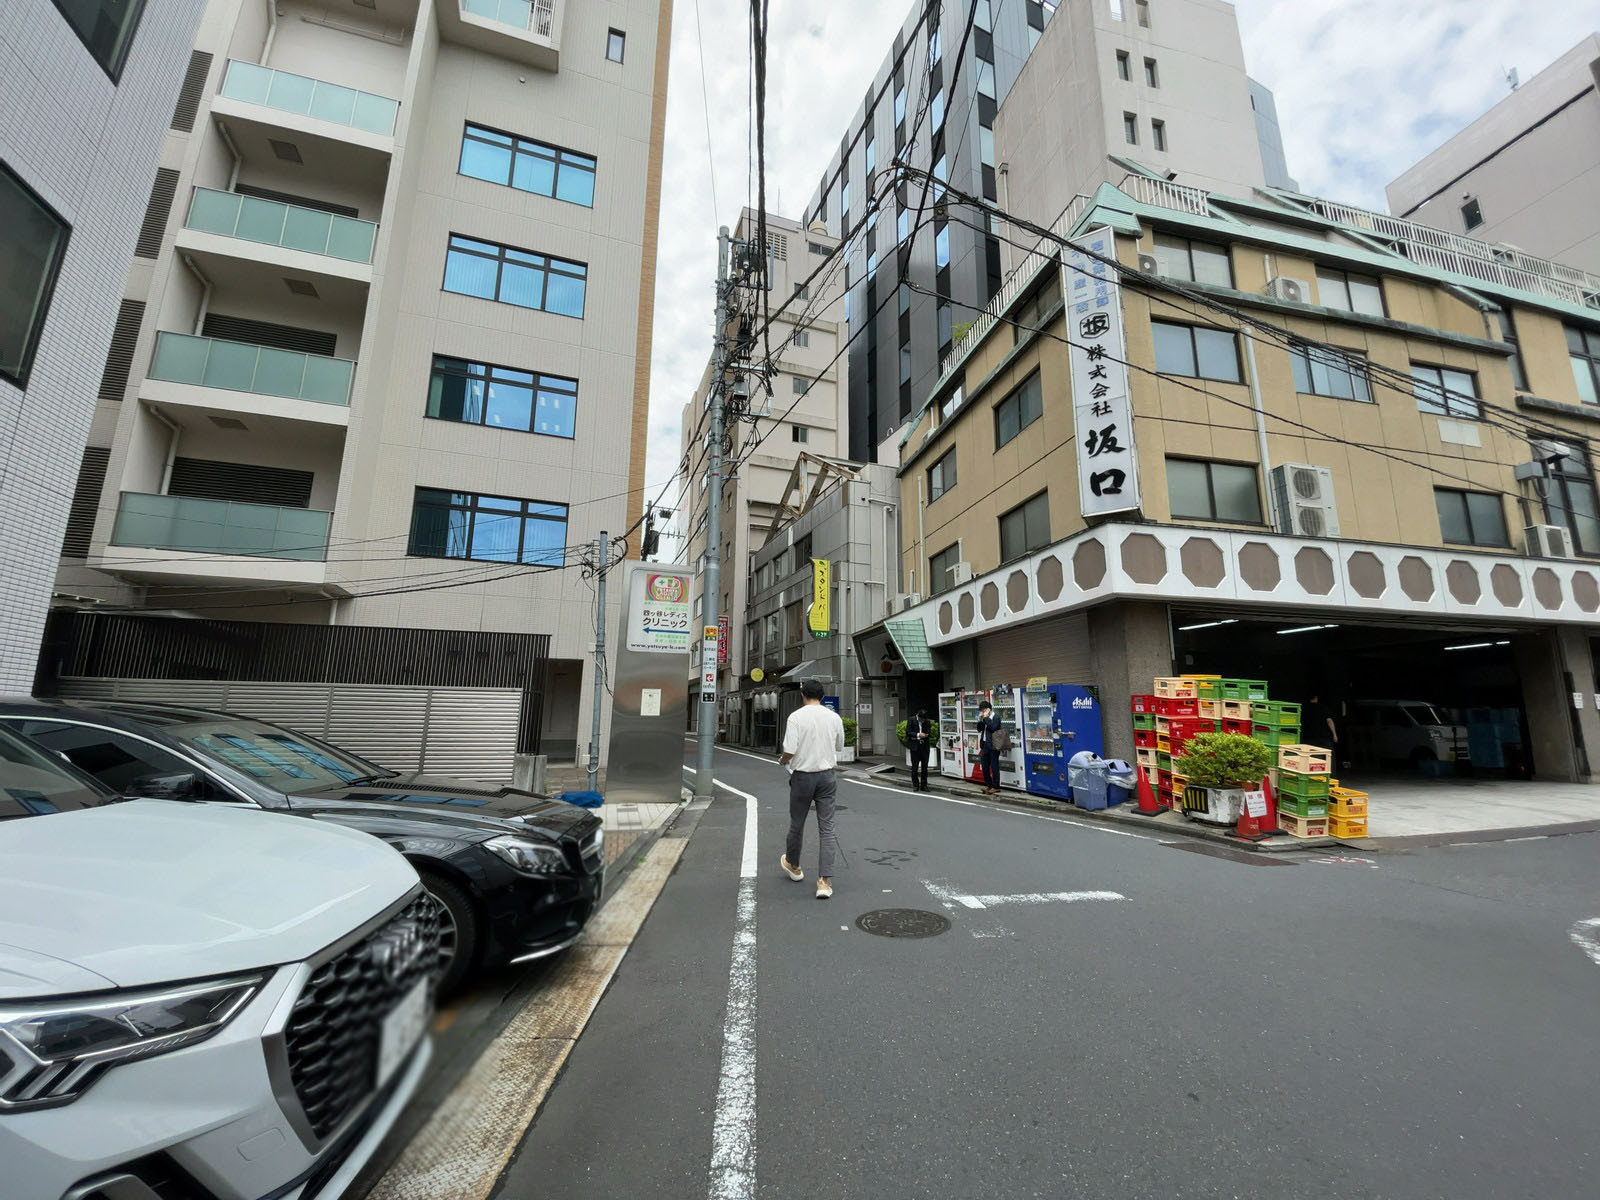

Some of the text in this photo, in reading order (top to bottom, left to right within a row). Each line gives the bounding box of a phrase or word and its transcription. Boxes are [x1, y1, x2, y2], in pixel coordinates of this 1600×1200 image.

[643, 618, 688, 628] クリニック
[1072, 697, 1092, 706] Asahi
